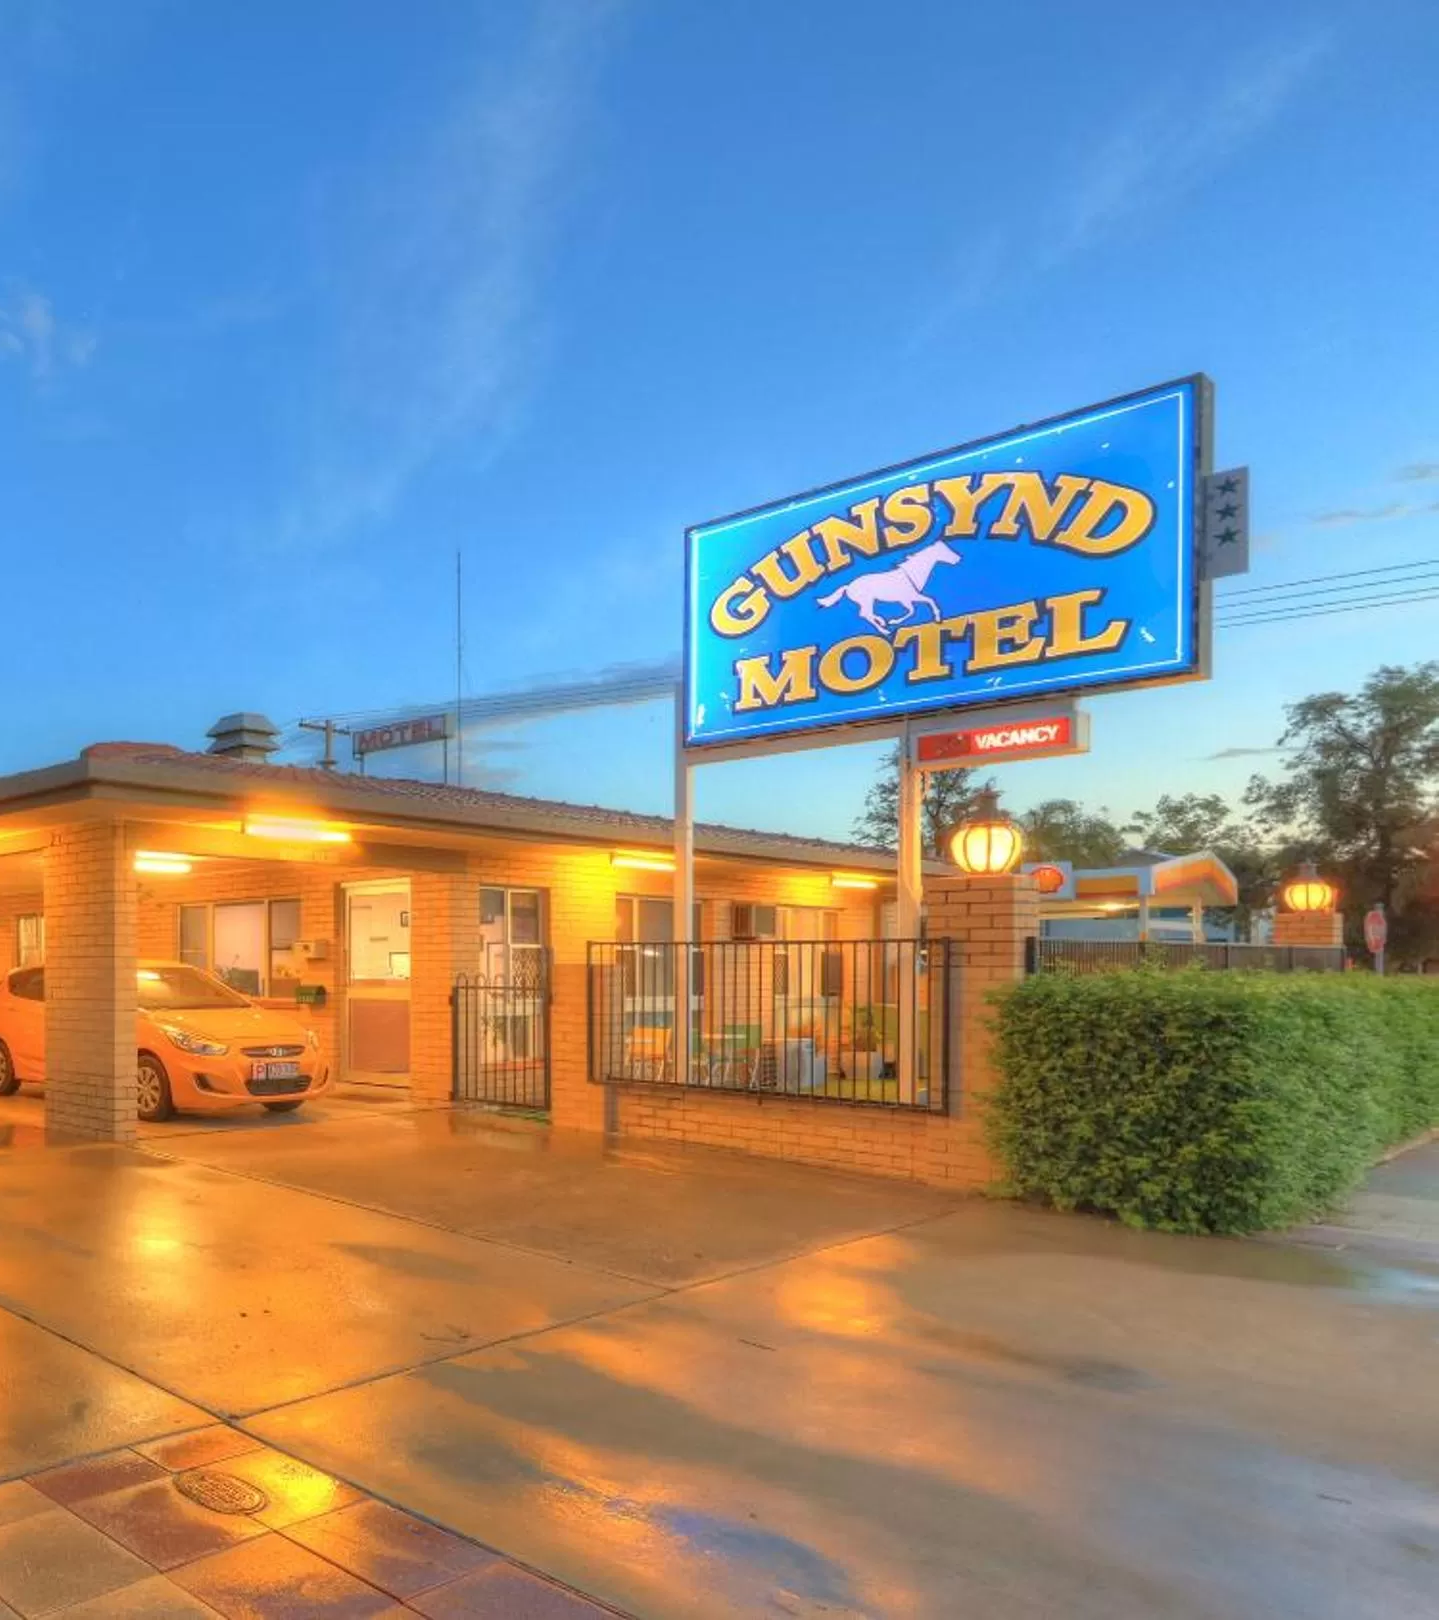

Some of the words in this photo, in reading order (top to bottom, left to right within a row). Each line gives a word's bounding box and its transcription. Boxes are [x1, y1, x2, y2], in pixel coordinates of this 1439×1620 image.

[710, 470, 1157, 639] GUNSYND
[734, 588, 1130, 712] MOTEL
[359, 719, 442, 750] MOTEL
[974, 724, 1060, 749] VACANCY
